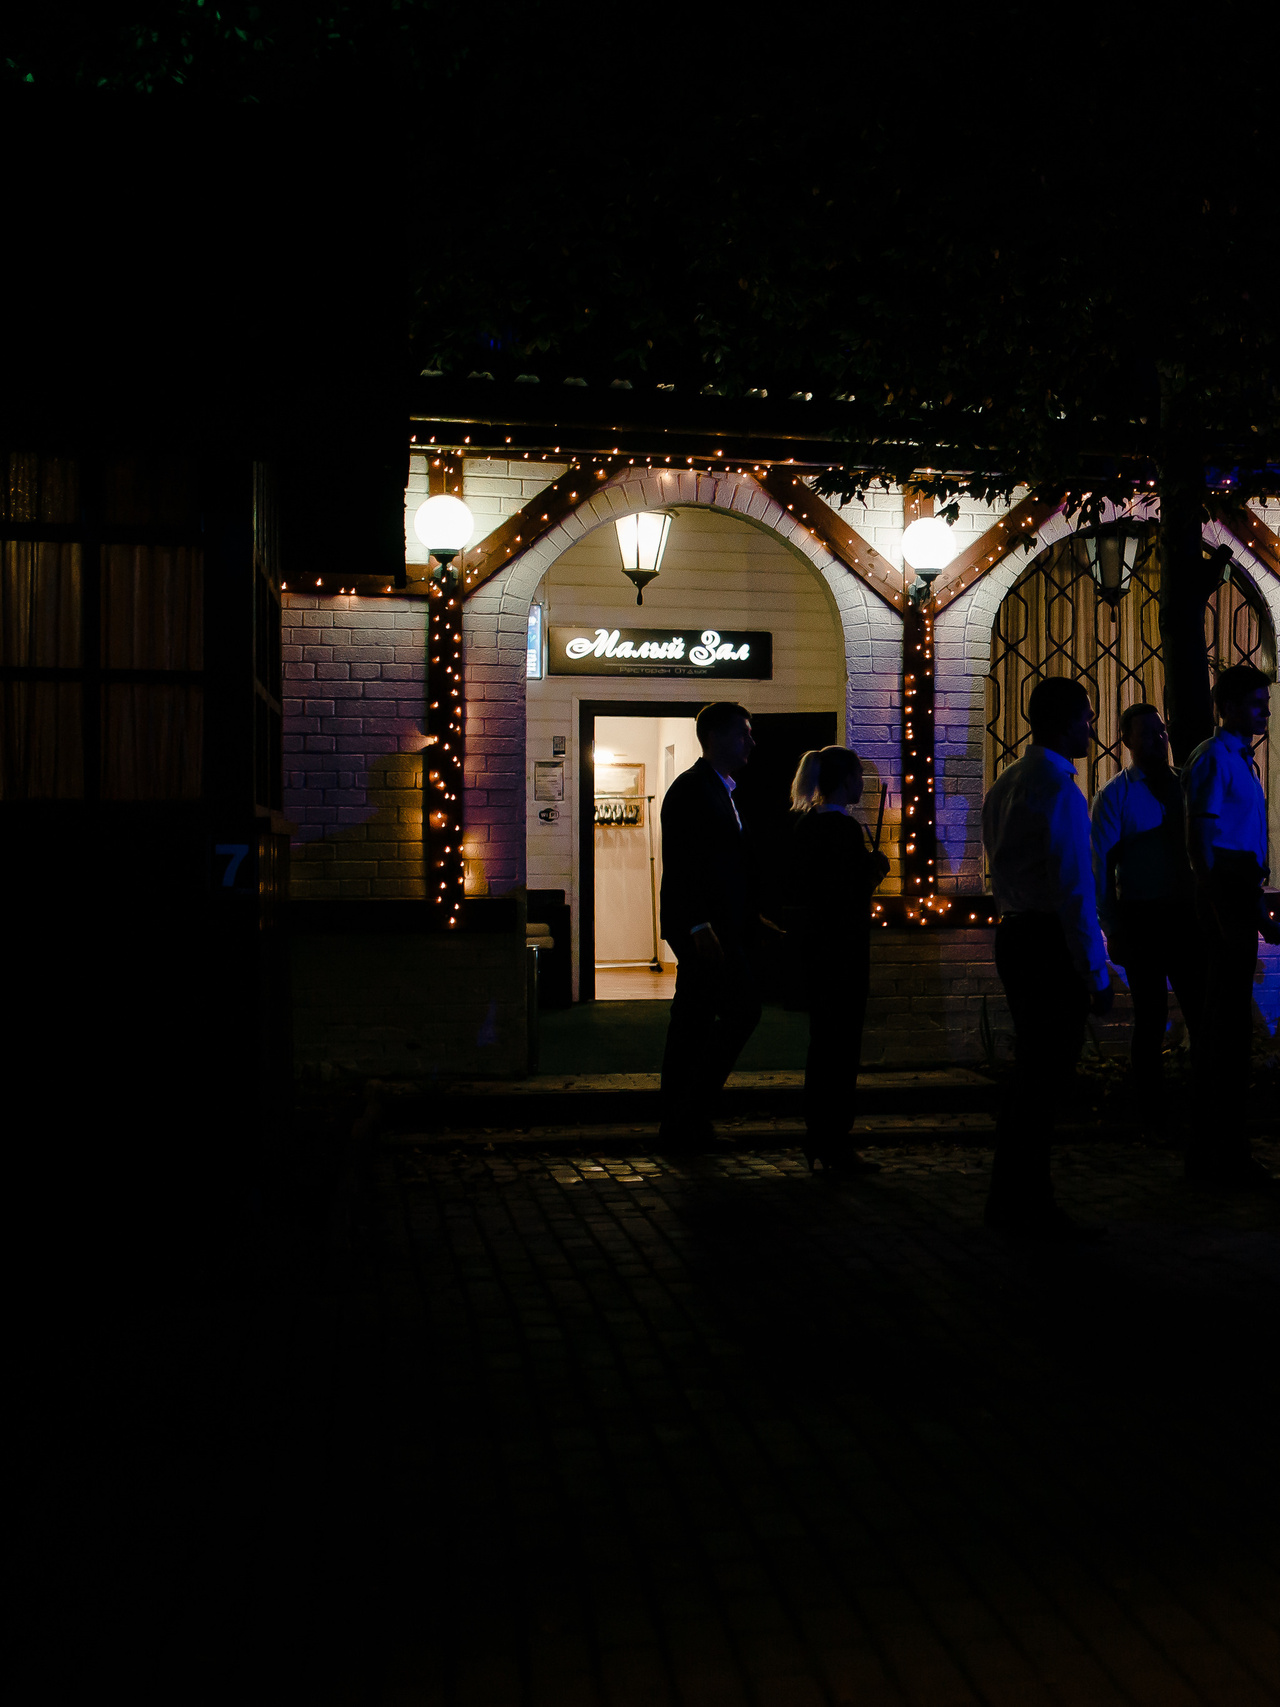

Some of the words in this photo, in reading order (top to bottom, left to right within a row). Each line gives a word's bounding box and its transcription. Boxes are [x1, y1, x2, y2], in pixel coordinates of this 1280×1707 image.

[566, 629, 685, 659] Малый
[689, 630, 750, 666] Зал
[214, 843, 250, 888] 7
